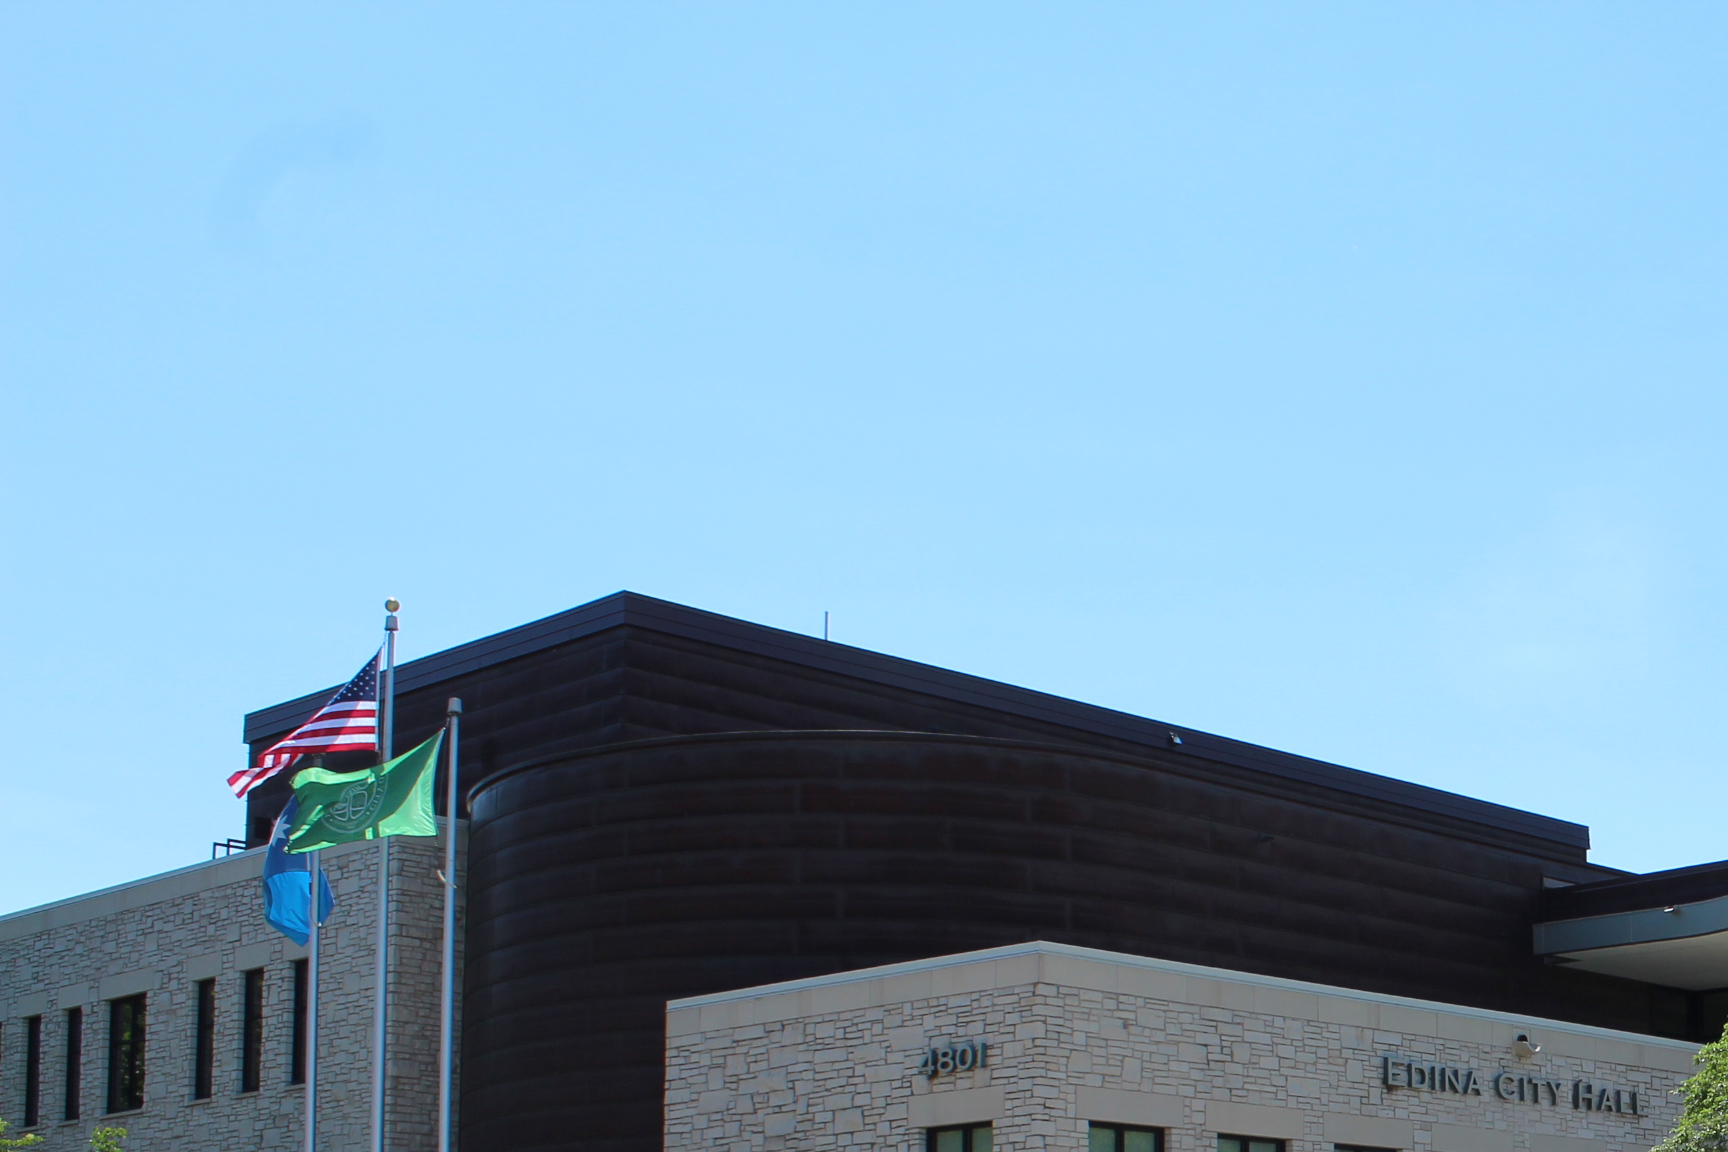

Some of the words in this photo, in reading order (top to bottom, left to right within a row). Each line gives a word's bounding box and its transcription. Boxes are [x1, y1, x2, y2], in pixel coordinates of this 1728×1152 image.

[919, 1042, 987, 1076] 4801
[1384, 1056, 1482, 1096] EDINA
[1495, 1072, 1562, 1106] CITY
[1573, 1080, 1649, 1117] HALL
